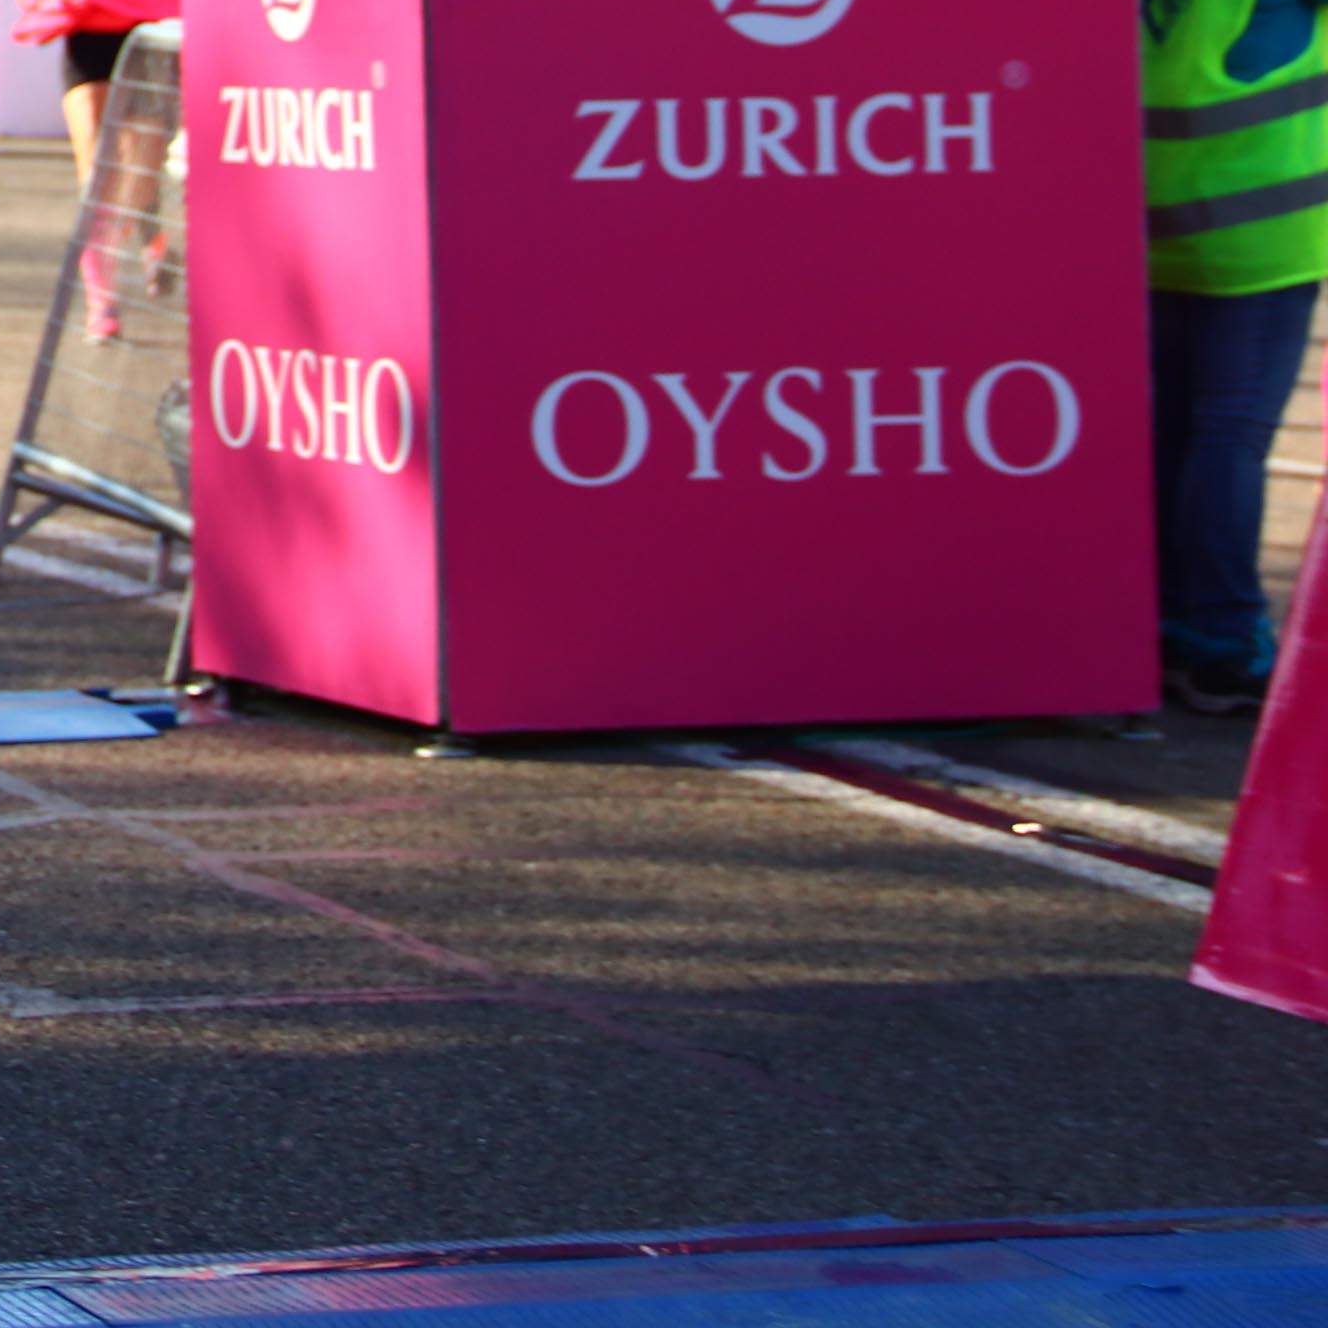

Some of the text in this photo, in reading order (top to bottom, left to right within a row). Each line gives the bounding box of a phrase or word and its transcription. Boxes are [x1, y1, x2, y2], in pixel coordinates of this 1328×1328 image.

[221, 85, 375, 170] ZURICH
[573, 92, 997, 180] ZURICH
[210, 339, 413, 473] OYSHO
[531, 360, 1081, 487] OYSHO
